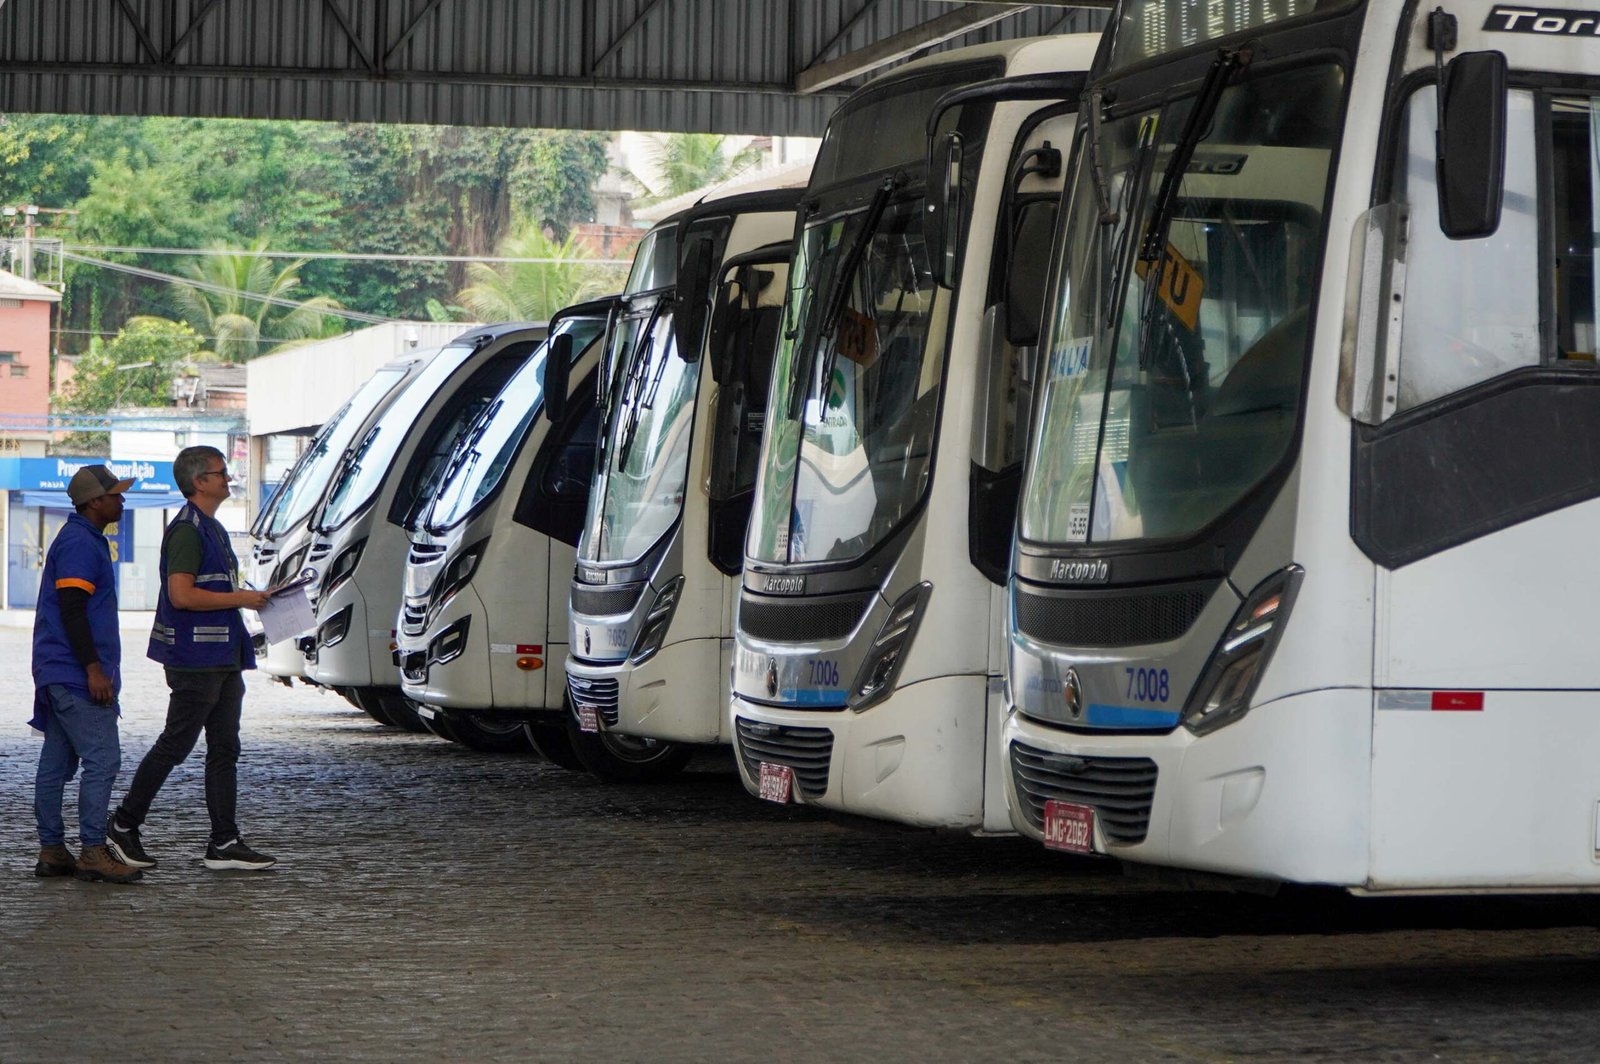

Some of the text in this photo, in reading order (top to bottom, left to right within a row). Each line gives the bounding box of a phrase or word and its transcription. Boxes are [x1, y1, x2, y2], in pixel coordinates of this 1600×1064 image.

[1050, 559, 1108, 582] Marcopolo
[763, 575, 804, 593] Marcopolo
[808, 660, 840, 687] 7.006
[1125, 667, 1170, 702] 7.008
